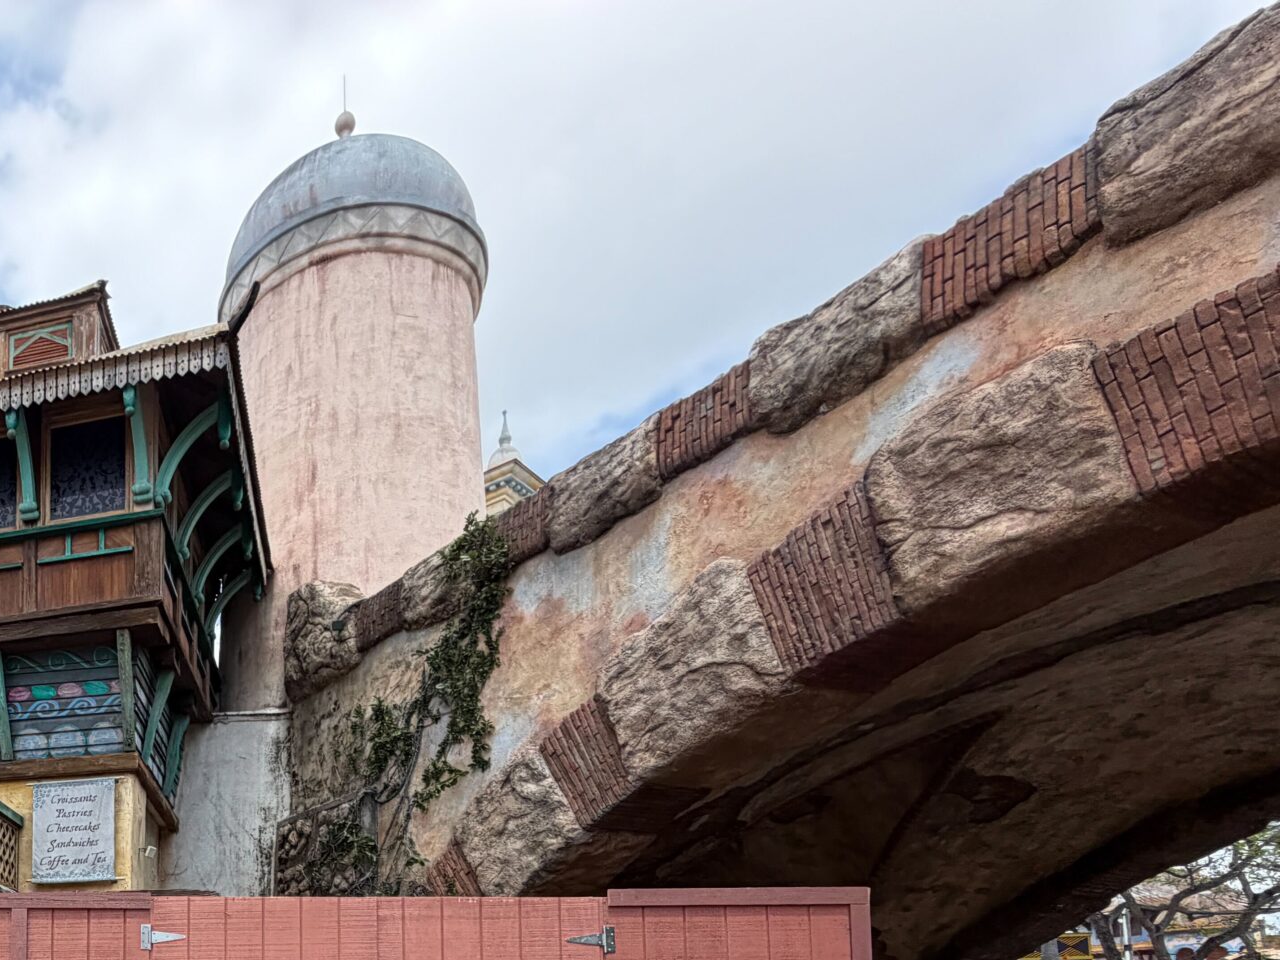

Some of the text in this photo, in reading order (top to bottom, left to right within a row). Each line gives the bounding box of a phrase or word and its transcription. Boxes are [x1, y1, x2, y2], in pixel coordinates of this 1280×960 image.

[51, 794, 97, 804] Croissants
[55, 808, 93, 818] Pastries
[47, 822, 100, 833] Cheesecakes
[47, 837, 100, 853] Sandwiches
[40, 851, 107, 871] Coffee and Tea
